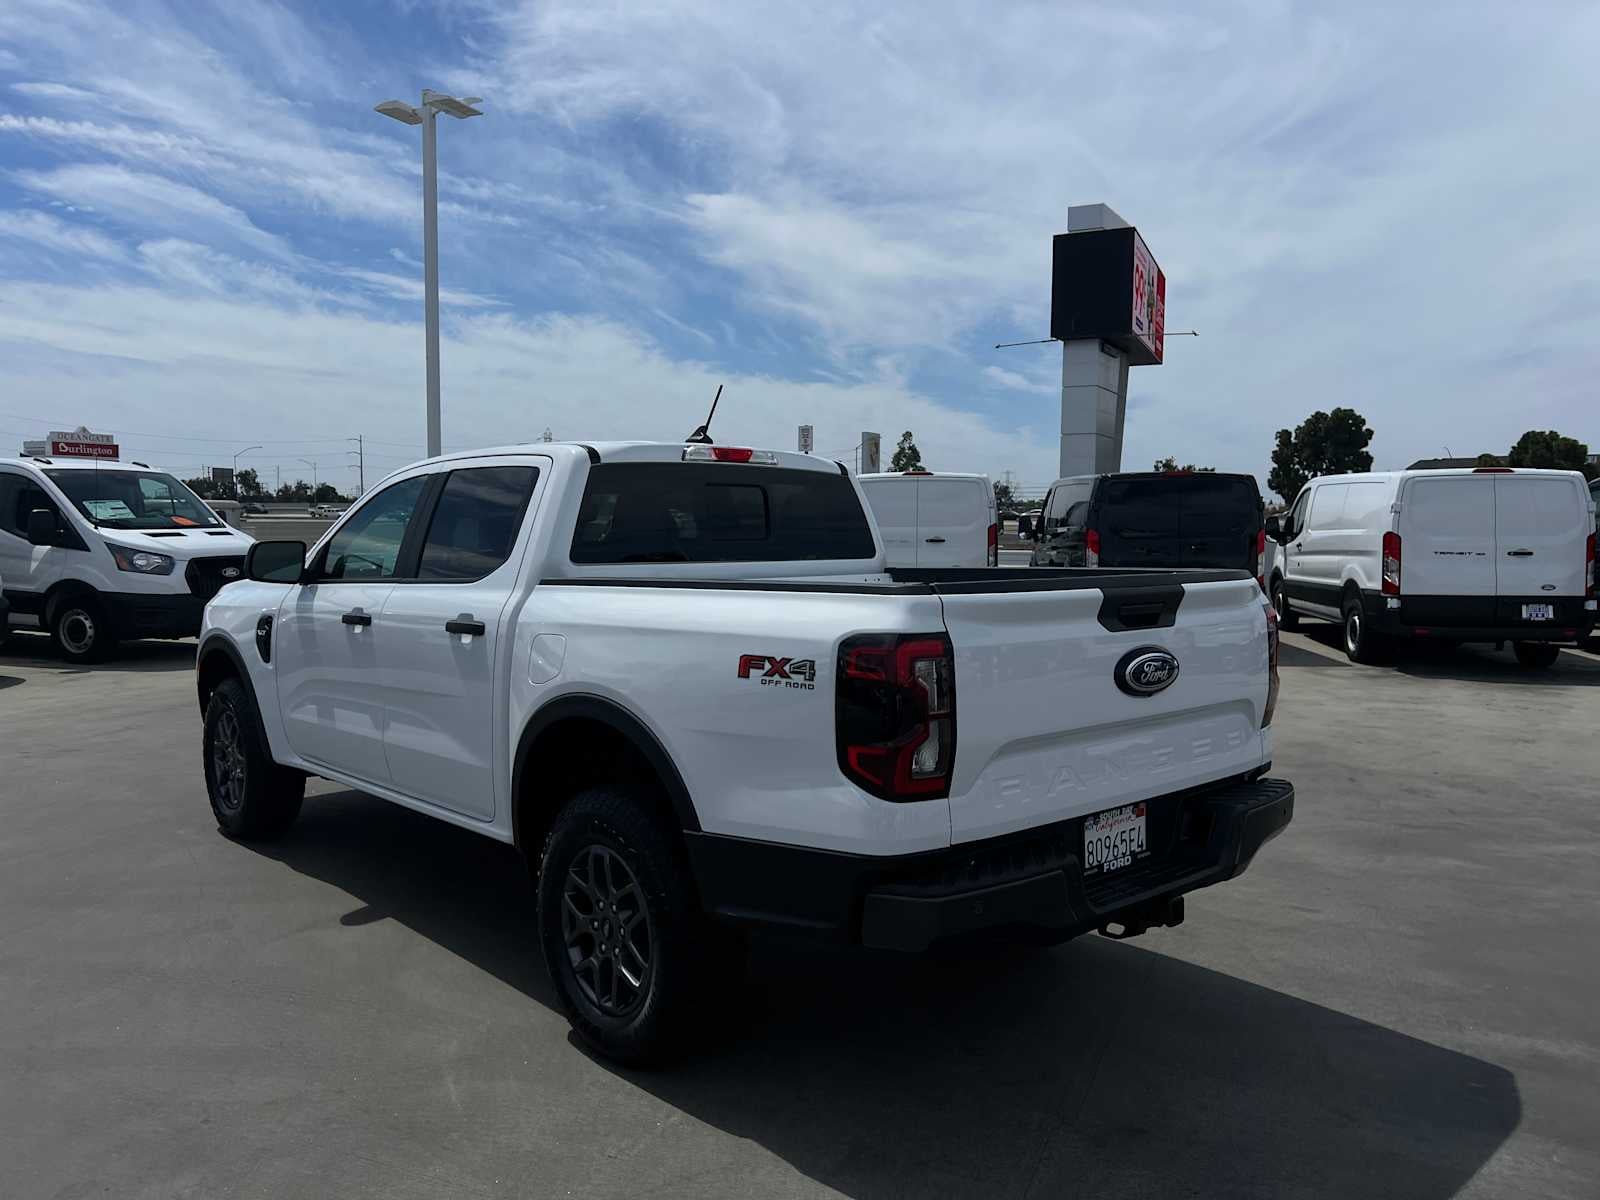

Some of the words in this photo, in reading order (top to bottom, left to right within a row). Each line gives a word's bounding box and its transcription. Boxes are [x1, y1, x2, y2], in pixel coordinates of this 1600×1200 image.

[58, 442, 112, 455] Burlington
[737, 654, 816, 681] FX4
[1141, 661, 1169, 683] Ford
[785, 681, 815, 690] ROAD
[1087, 825, 1144, 866] 80965E4
[1103, 856, 1132, 873] FORD
